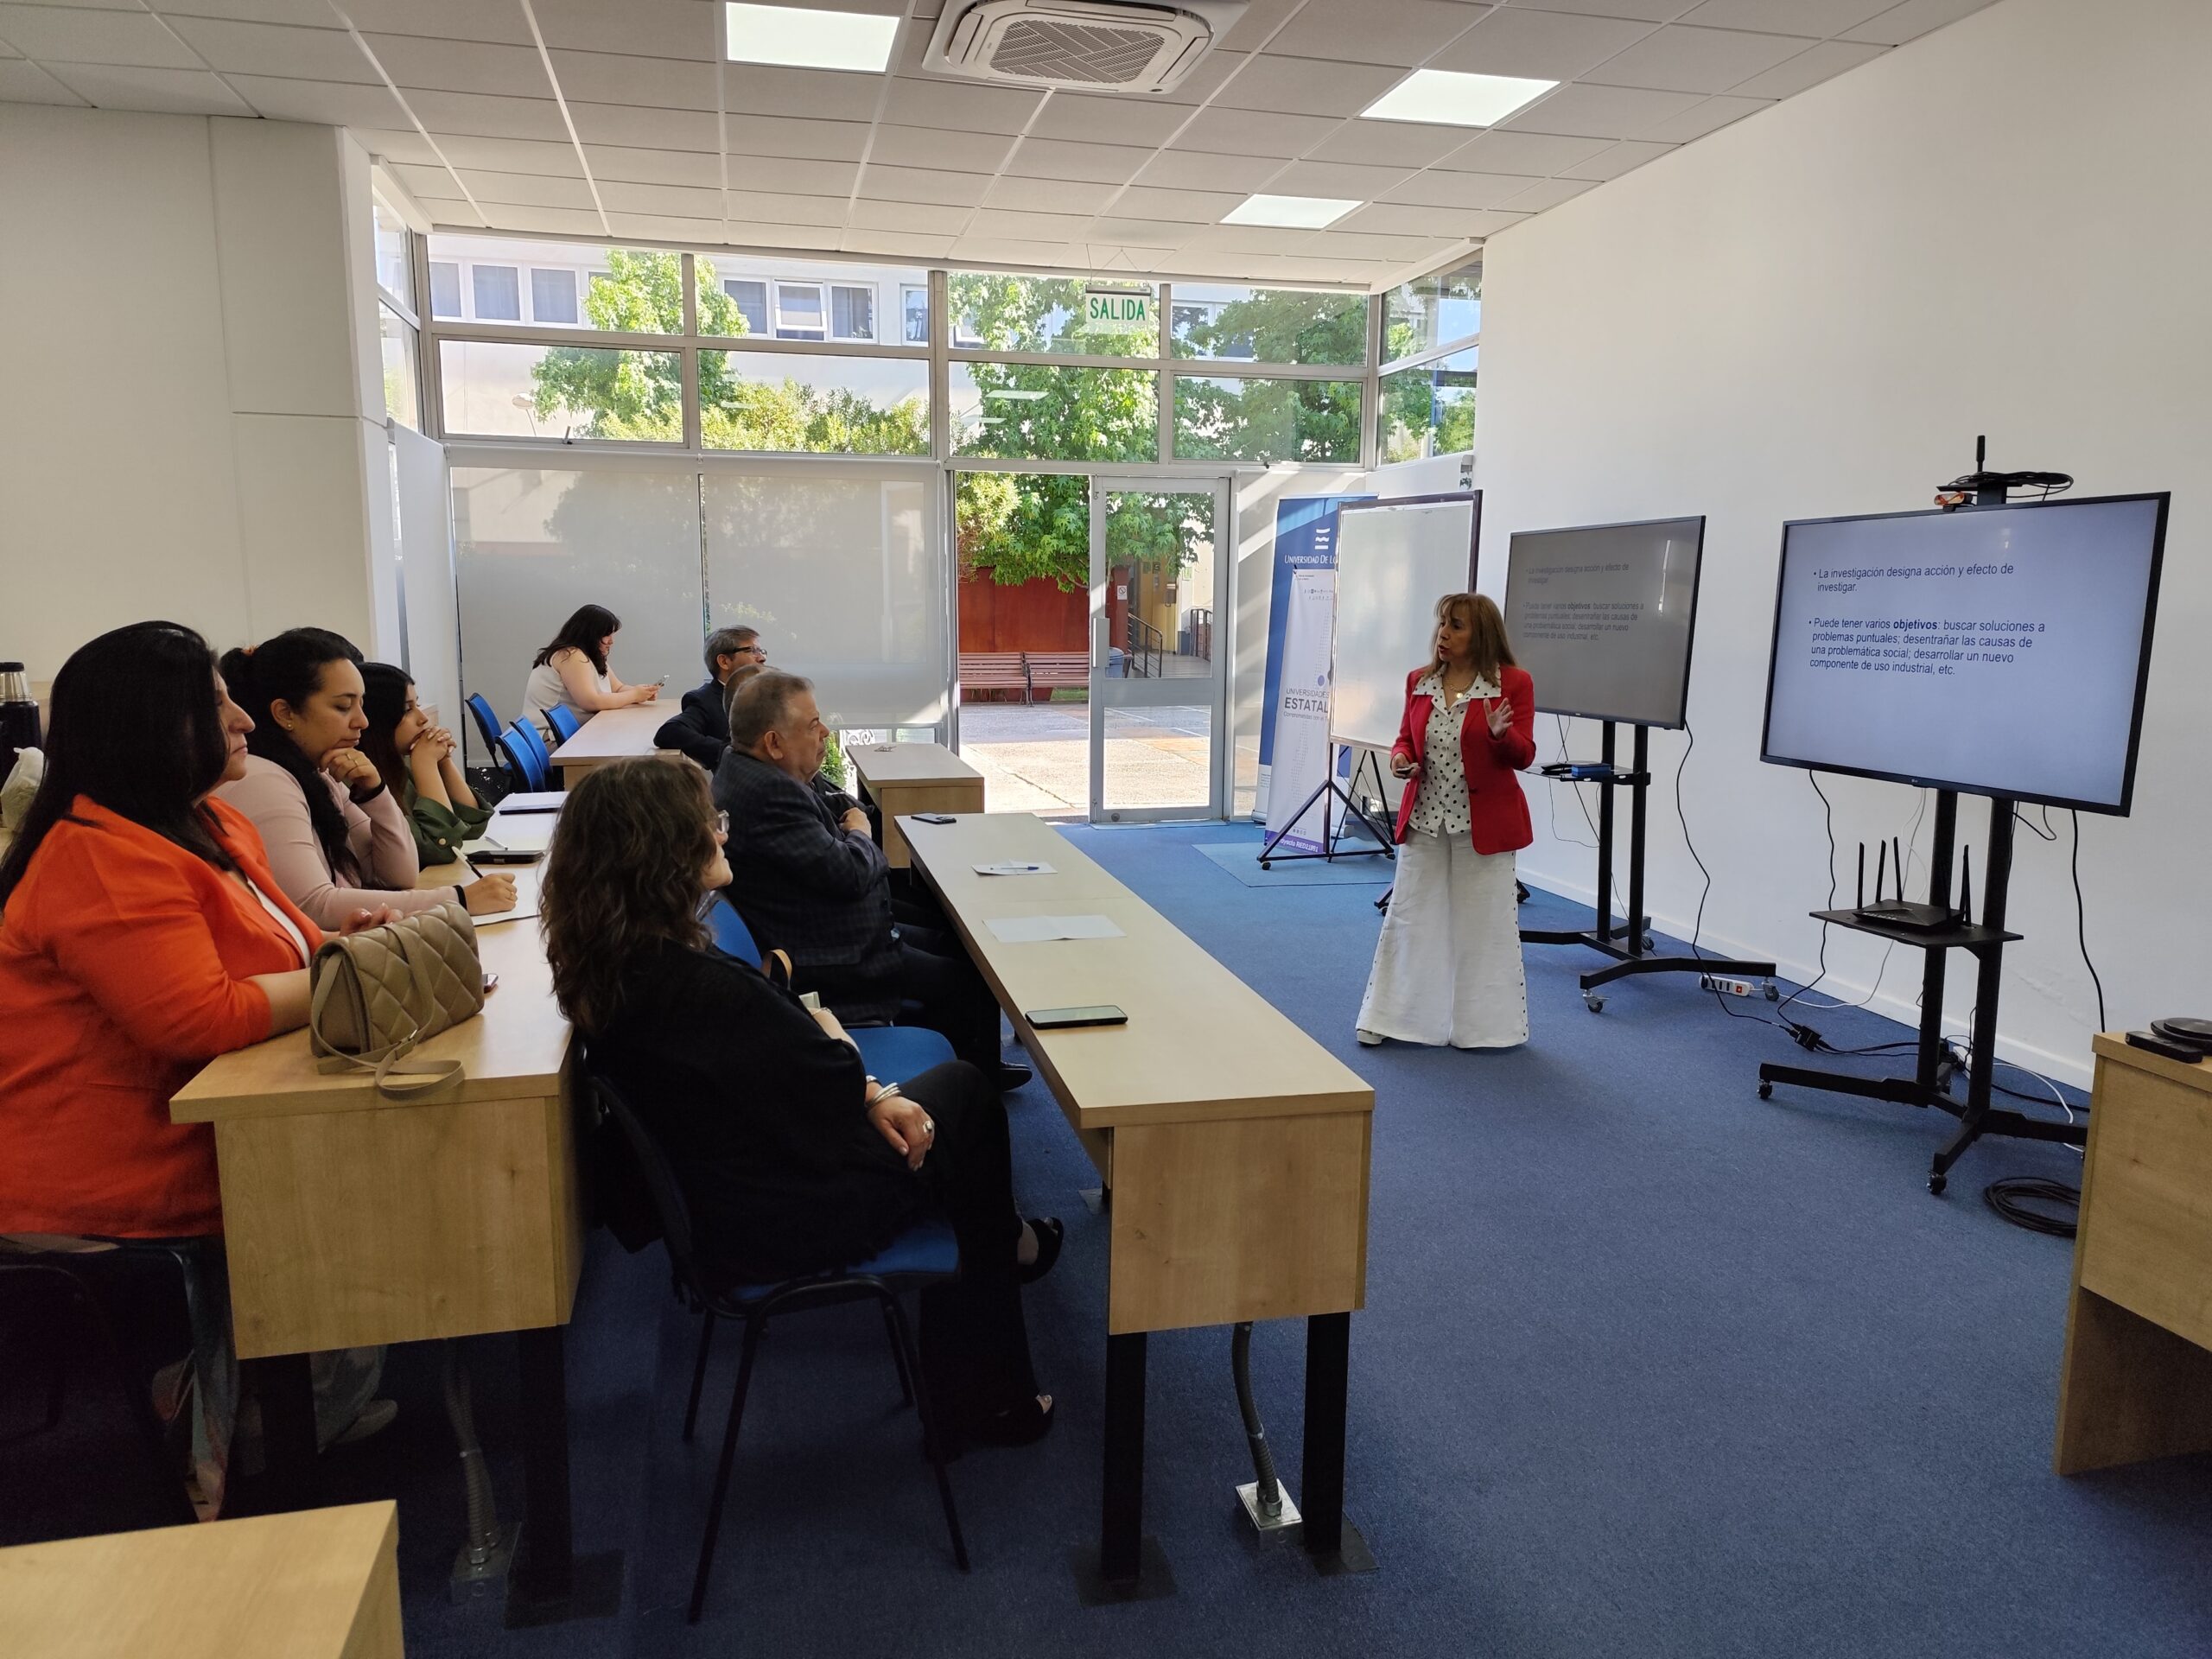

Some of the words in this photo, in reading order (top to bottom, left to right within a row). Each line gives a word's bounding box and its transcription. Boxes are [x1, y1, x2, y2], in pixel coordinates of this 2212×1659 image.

[1090, 297, 1146, 321] SALIDA
[1284, 554, 1319, 564] UNIVERSIDAD
[1819, 569, 1828, 579] La
[1830, 566, 1885, 580] investigación
[1887, 566, 1922, 579] designa
[1923, 564, 1955, 576] acción
[1958, 566, 1965, 578] y
[1967, 563, 1998, 575] efecto
[2000, 563, 2014, 575] de
[1817, 582, 1858, 594] investigar.
[1814, 617, 1840, 628] Puede
[1841, 618, 1863, 628] tener
[1865, 619, 1891, 629] varios
[1893, 619, 1941, 632] objetivos:
[1943, 619, 1978, 631] buscar
[1979, 620, 2035, 632] soluciones
[2037, 623, 2045, 632] a
[1812, 632, 1854, 643] problemas
[1856, 632, 1901, 645] puntuales;
[1903, 633, 1960, 645] desentrañar
[1961, 634, 1976, 646] las
[1979, 638, 2017, 648] causas
[2018, 636, 2032, 648] de
[1811, 646, 1826, 655] una
[1827, 645, 1880, 657] problemática
[1882, 647, 1911, 659] social;
[1913, 648, 1964, 660] desarrollar
[1967, 652, 1980, 662] un
[1982, 653, 2014, 664] nuevo
[1809, 659, 1859, 671] componente
[1861, 660, 1872, 671] de
[1874, 663, 1891, 671] uso
[1892, 662, 1936, 676] industrial,
[1938, 664, 1955, 676] etc.
[1286, 688, 1331, 699] UNIVERSIDADES
[1284, 696, 1329, 714] ESTATAL
